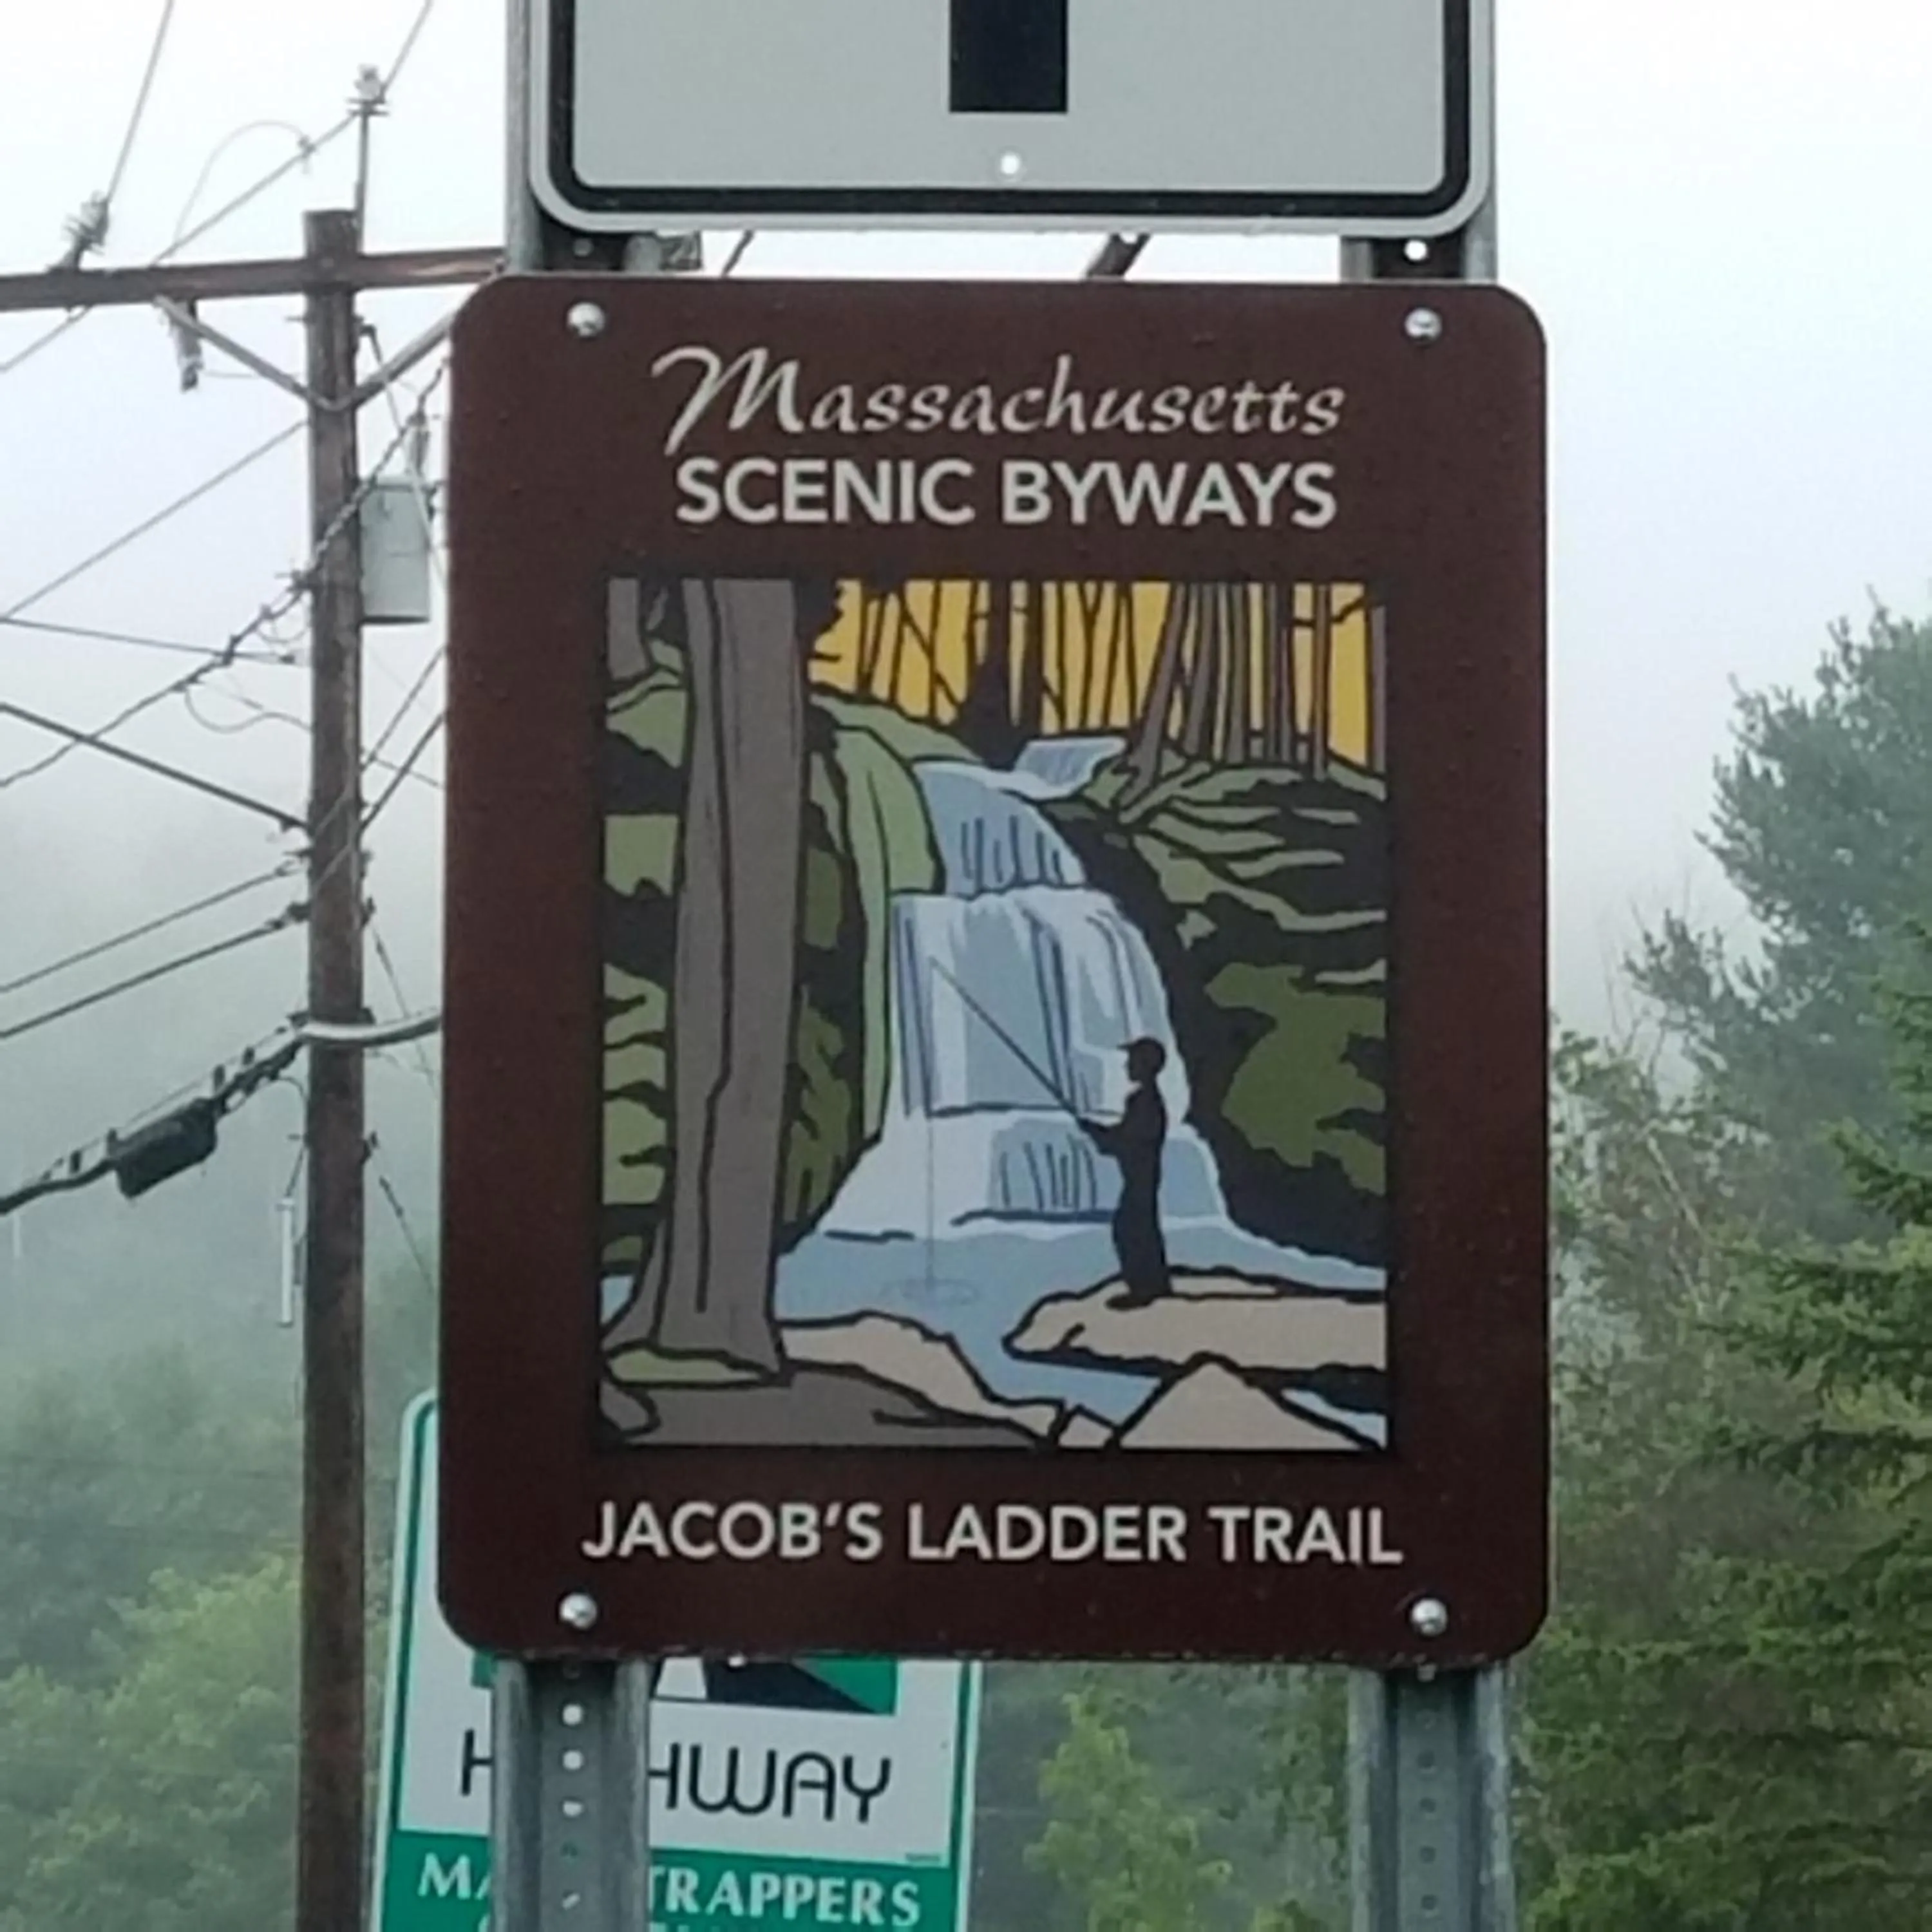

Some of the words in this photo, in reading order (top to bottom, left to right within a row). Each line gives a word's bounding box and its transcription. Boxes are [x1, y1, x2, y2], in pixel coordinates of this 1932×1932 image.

[652, 346, 1344, 455] Massachusetts
[676, 456, 976, 525] SCENIC
[1002, 459, 1338, 529] BYWAYS
[582, 1501, 883, 1560] JACOB'S
[908, 1503, 1187, 1562] LADDER
[1208, 1505, 1404, 1566] TRAIL
[460, 1728, 891, 1824] HHWAY
